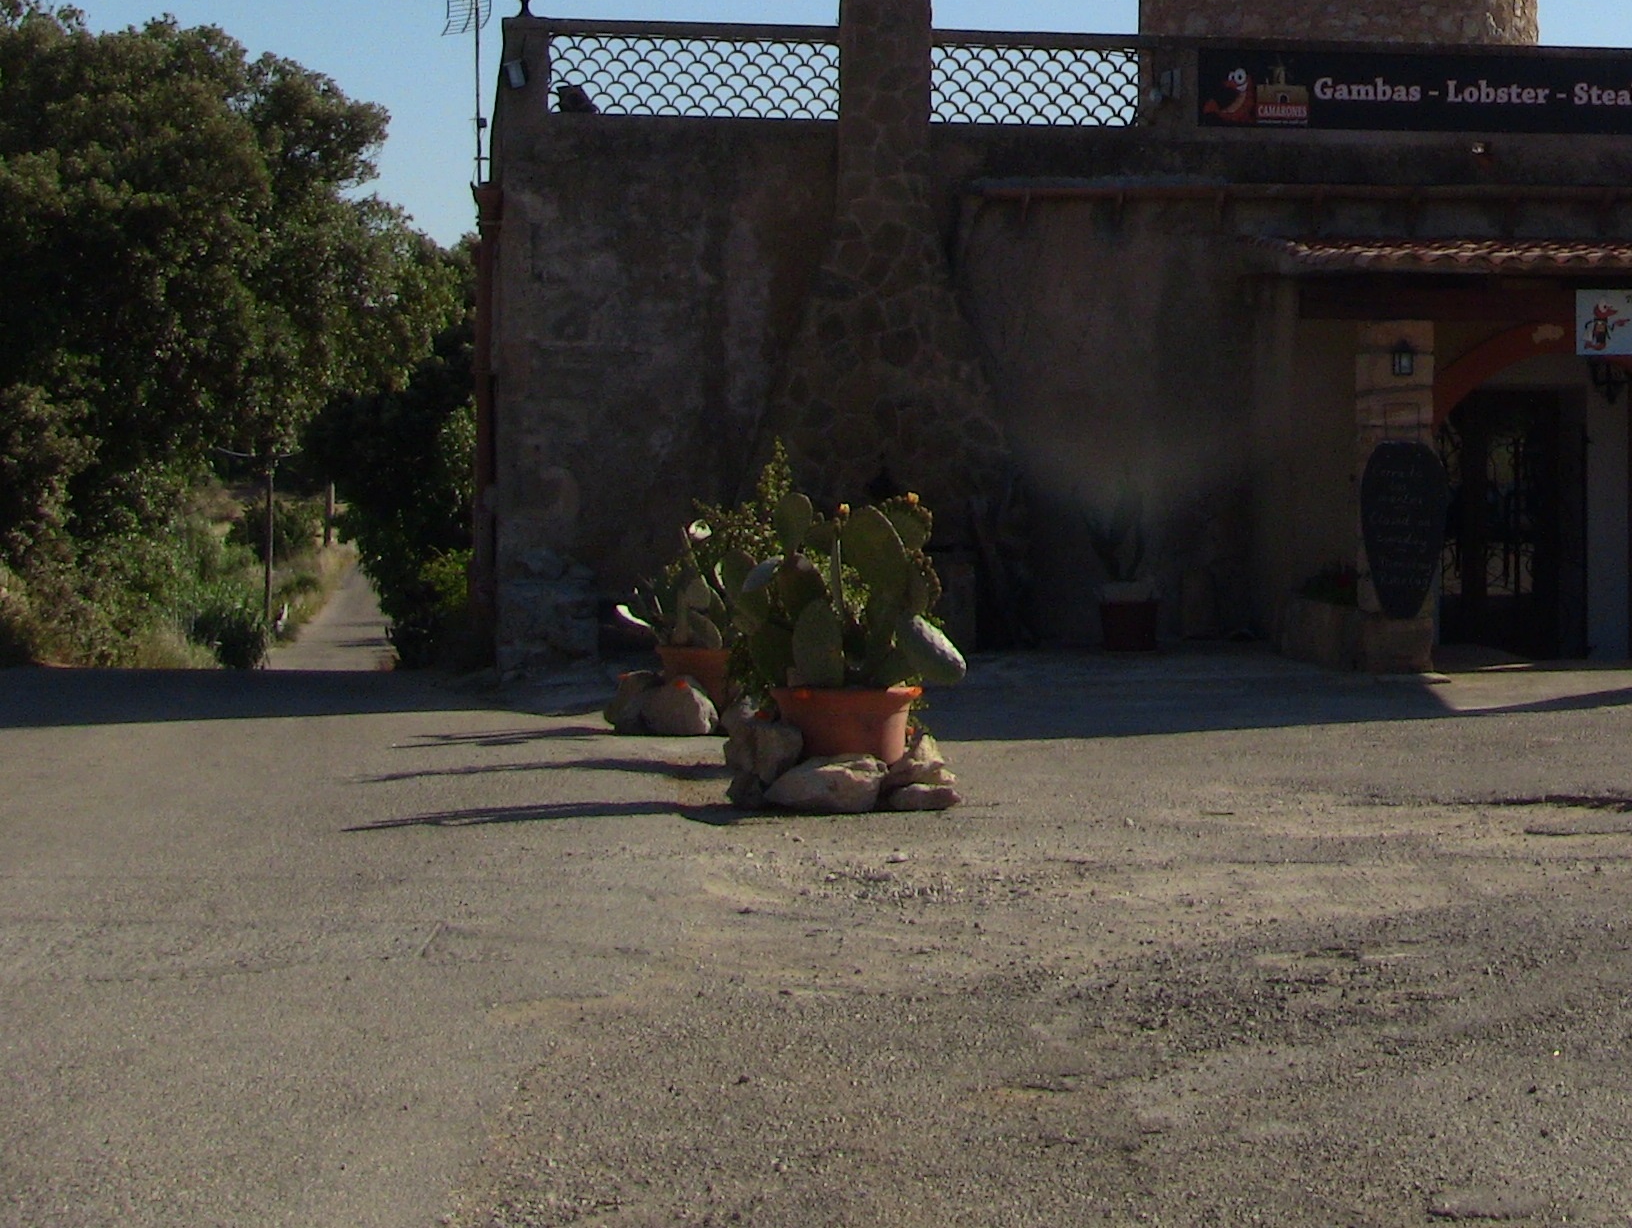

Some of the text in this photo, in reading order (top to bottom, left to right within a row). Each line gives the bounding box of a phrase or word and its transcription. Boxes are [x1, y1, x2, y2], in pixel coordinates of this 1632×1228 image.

[1314, 76, 1421, 102] Gambas
[1447, 79, 1550, 104] Lobster
[1257, 105, 1307, 117] CAMARONES
